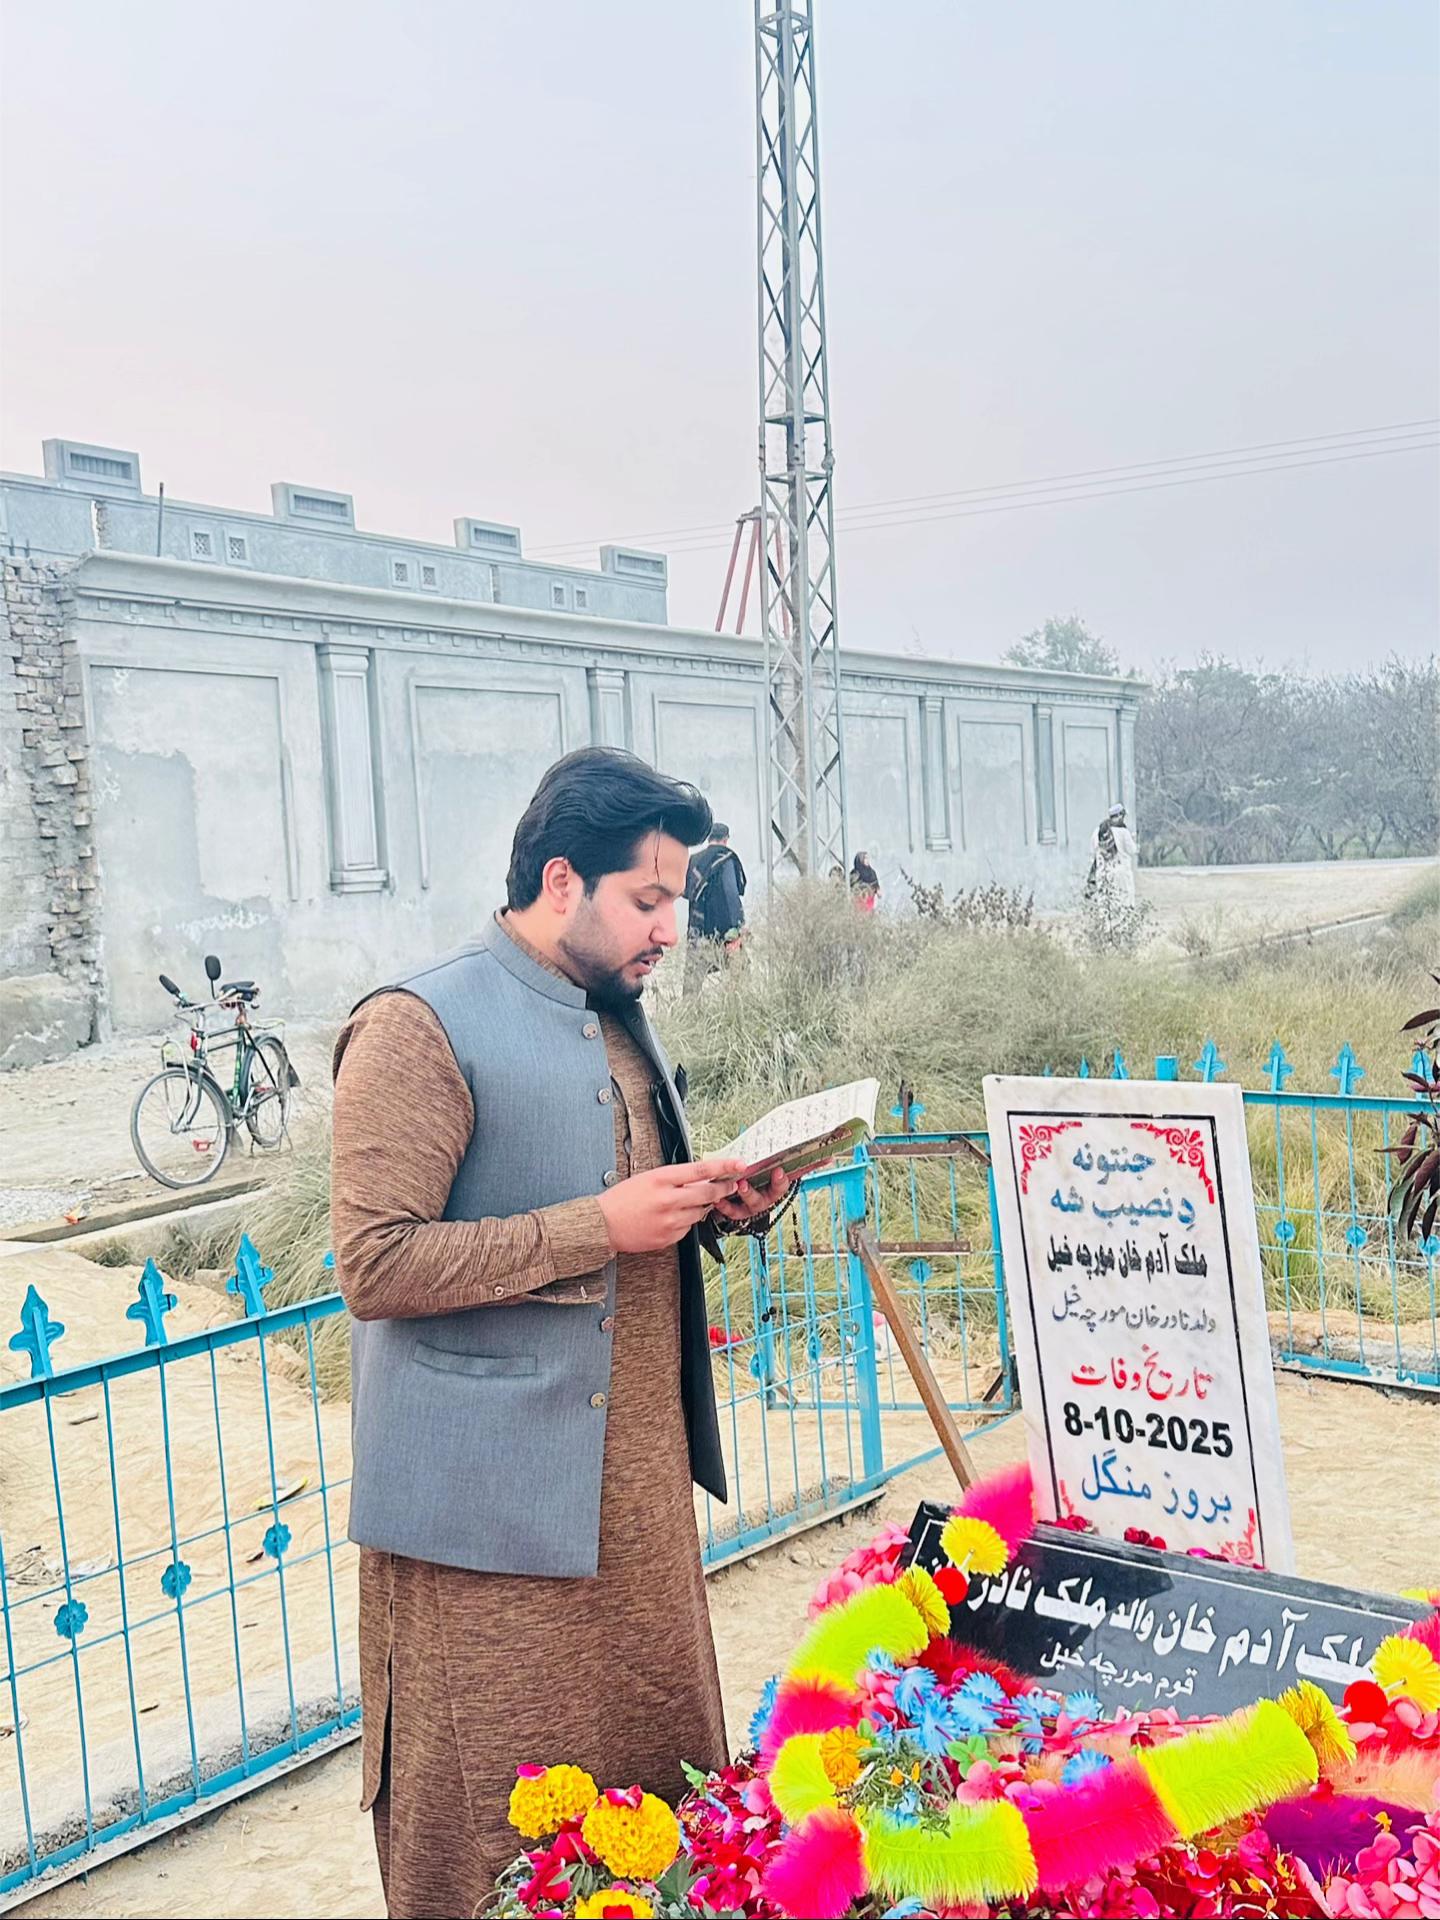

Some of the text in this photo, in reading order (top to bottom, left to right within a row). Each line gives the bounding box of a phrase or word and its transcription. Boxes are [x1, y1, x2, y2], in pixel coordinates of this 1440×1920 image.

[1118, 1239, 1142, 1278] خان
[1145, 1231, 1170, 1284] آدم
[1174, 1243, 1208, 1278] ملک
[1126, 1304, 1160, 1330] خان
[1189, 1308, 1216, 1333] ولد
[1071, 1343, 1214, 1400] تاریخ وفات
[1063, 1402, 1234, 1458] 8-10-2025
[1082, 1449, 1232, 1523] بروز منگل
[967, 1565, 1032, 1612] نادر
[1034, 1577, 1107, 1630] ملک
[1109, 1598, 1154, 1642] والد
[1153, 1602, 1217, 1655] خان
[1217, 1607, 1309, 1677] آدم
[1040, 1641, 1085, 1670] خیل
[1154, 1667, 1198, 1700] قوم
